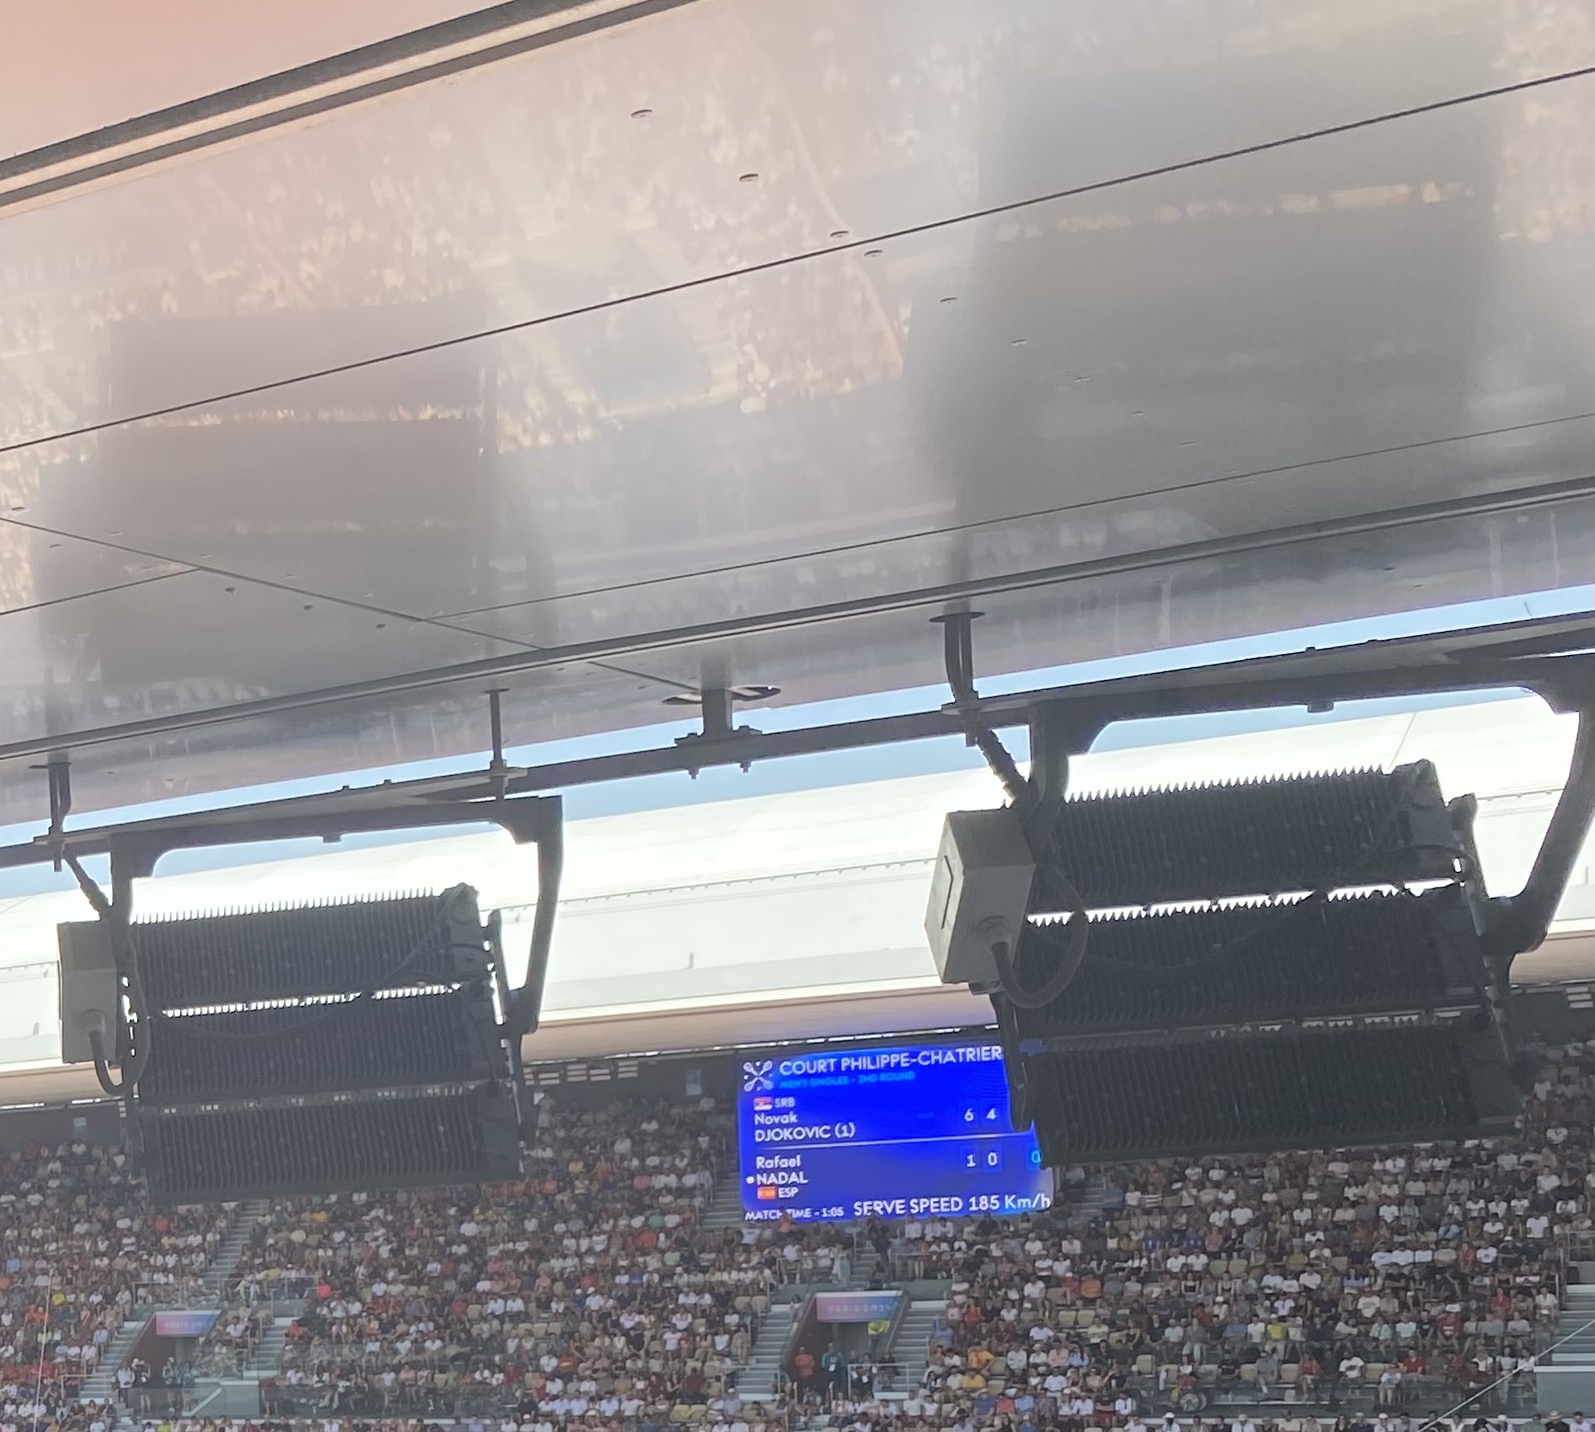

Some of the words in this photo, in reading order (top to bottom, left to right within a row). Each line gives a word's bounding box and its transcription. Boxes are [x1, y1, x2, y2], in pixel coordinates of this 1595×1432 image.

[779, 1058, 837, 1076] COURT
[841, 1045, 1003, 1071] PHILIPPE-CHATRIER
[775, 1097, 795, 1108] SRB
[754, 1111, 798, 1125] Novak
[964, 1108, 974, 1122] 6
[986, 1108, 996, 1120] 4
[755, 1125, 831, 1142] DJOKOVIC
[834, 1122, 855, 1138] (1)
[756, 1154, 801, 1169] Rafael
[967, 1154, 976, 1167] 1
[988, 1152, 997, 1166] 0
[757, 1171, 808, 1185] NADAL
[778, 1187, 799, 1198] ESP
[854, 1199, 906, 1216] SERVE
[909, 1197, 963, 1214] SPEED
[969, 1195, 1000, 1211] 185
[1004, 1193, 1051, 1209] Km/h
[821, 1207, 844, 1217] 1:05
